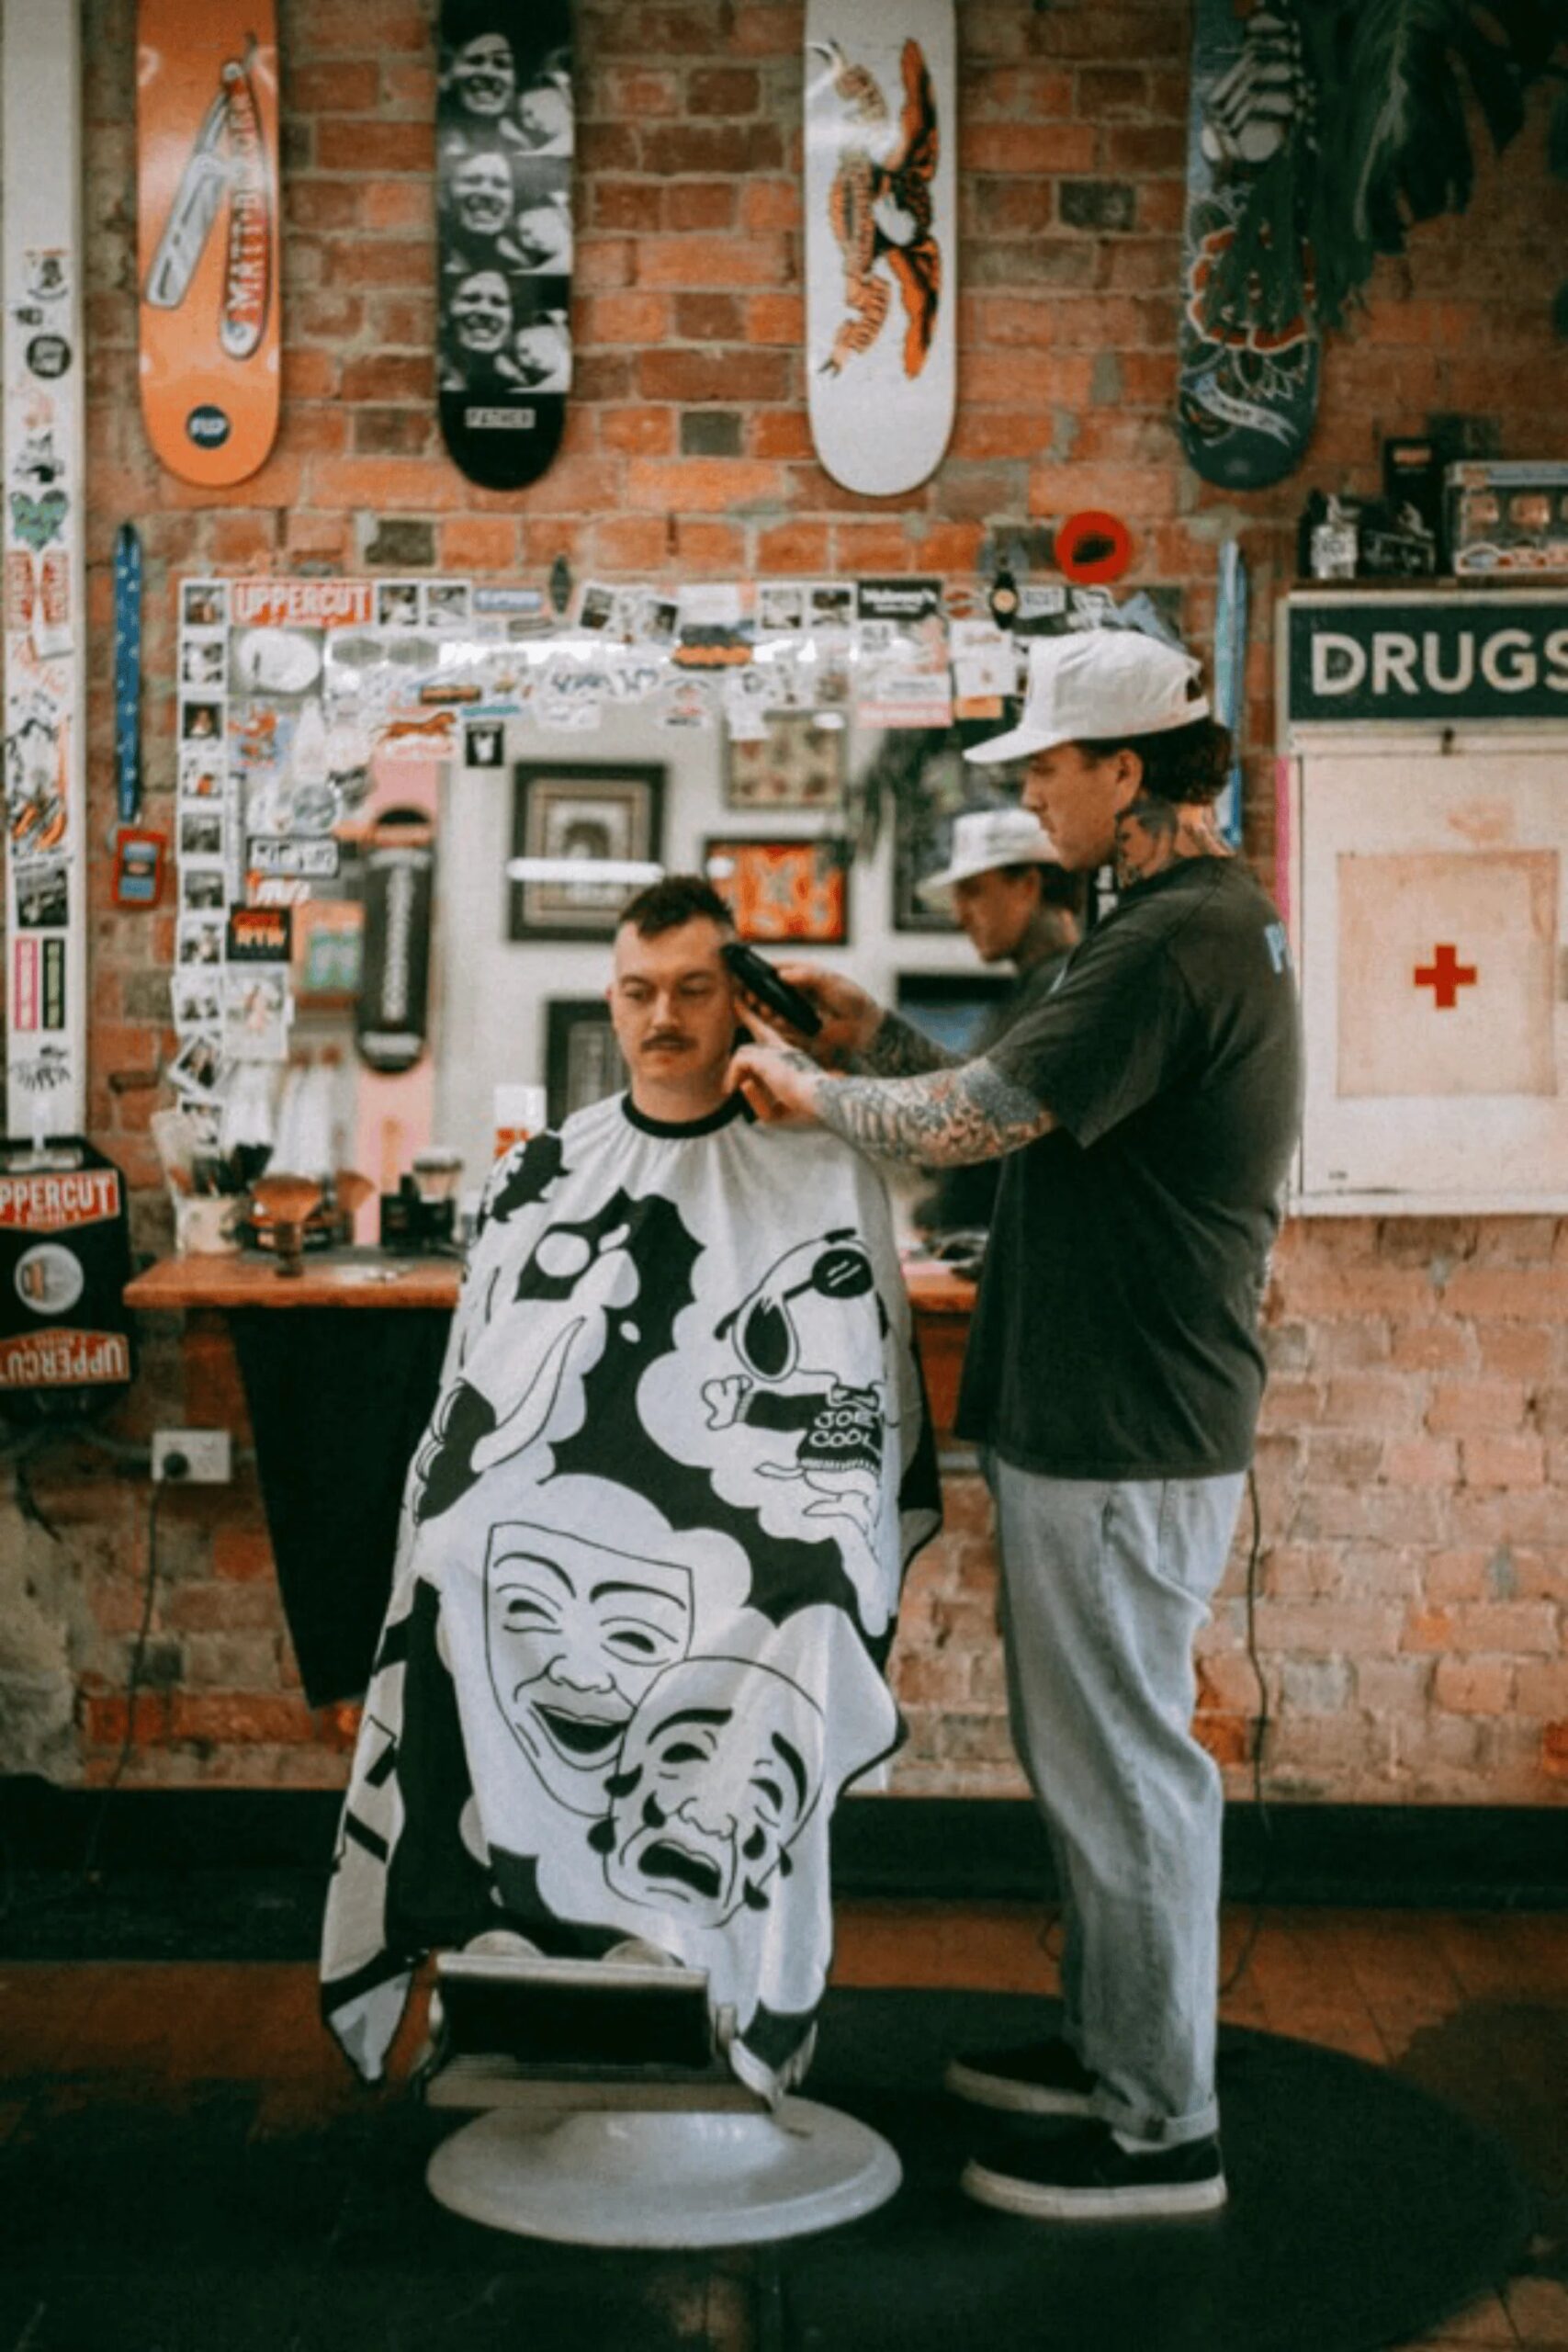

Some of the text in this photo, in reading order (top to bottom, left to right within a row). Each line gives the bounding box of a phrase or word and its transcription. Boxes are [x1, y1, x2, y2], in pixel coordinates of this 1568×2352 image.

[236, 586, 369, 619] UPPERCUT
[1312, 628, 1568, 695] DRUGS
[814, 1410, 875, 1430] JOE
[809, 1429, 881, 1455] COOL
